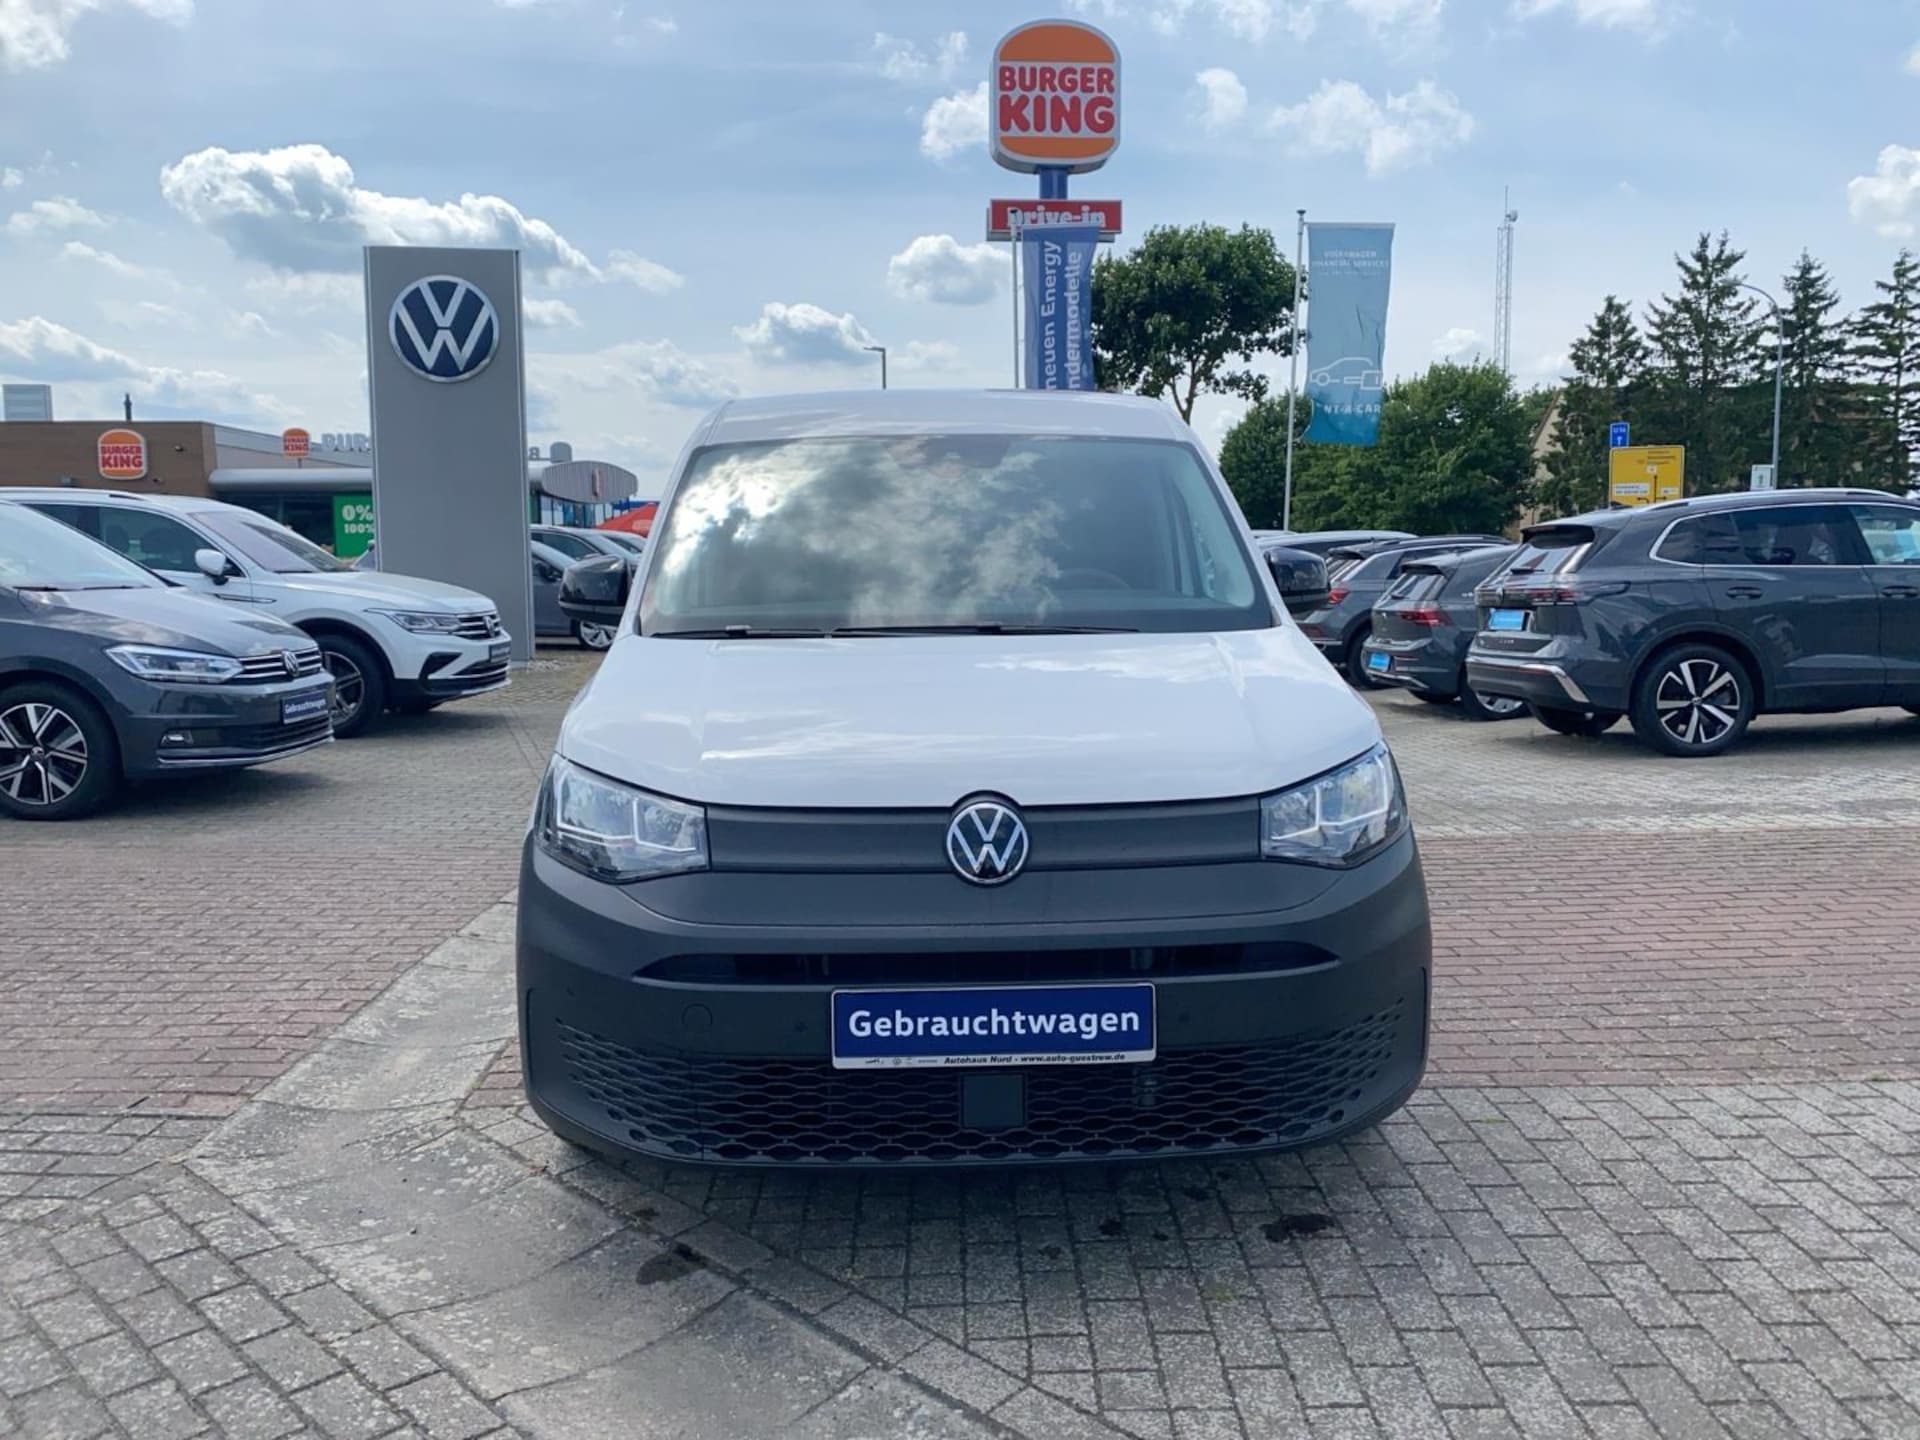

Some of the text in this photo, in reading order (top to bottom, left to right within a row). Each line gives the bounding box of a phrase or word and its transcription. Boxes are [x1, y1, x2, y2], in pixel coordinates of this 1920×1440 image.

[999, 66, 1115, 93] BURGER
[999, 94, 1115, 134] KING
[1007, 205, 1106, 227] Drive-in
[1041, 240, 1062, 389] neuen Energy
[101, 446, 142, 455] BURGER
[102, 455, 142, 468] KING
[342, 505, 373, 521] 0%
[849, 1008, 1140, 1040] Gebrauchtwagen
[944, 1057, 988, 1065] Autohaus
